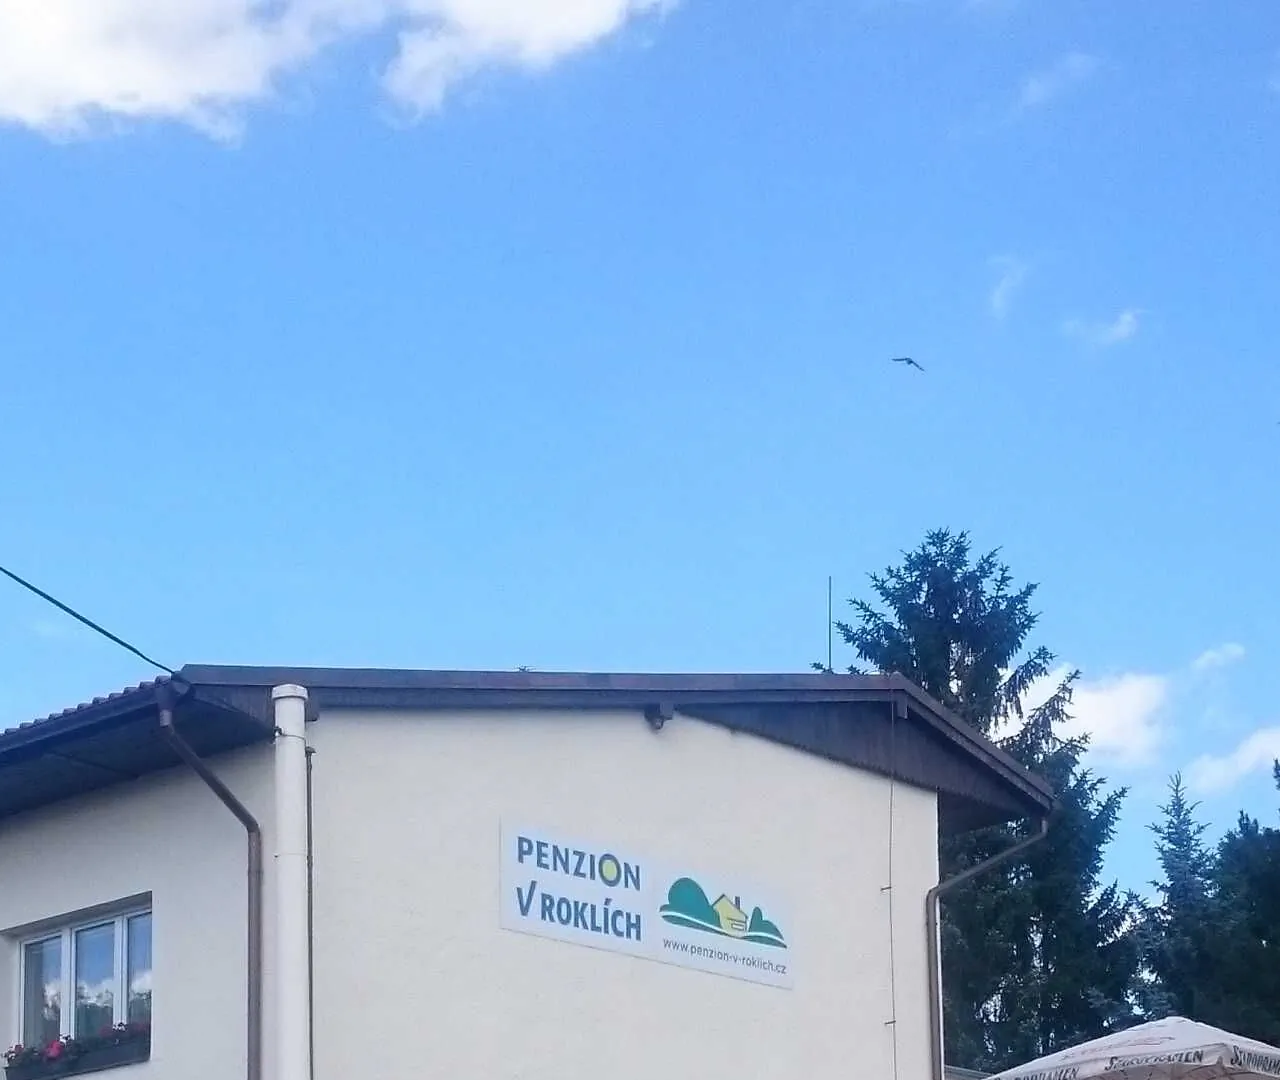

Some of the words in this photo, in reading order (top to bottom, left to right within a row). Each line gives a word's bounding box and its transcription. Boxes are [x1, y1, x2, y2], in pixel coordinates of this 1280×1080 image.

[516, 836, 641, 892] PENZION
[516, 880, 537, 917] V
[540, 892, 642, 942] ROKLÍCH
[663, 938, 787, 975] www.penzion-v-roklich.cz
